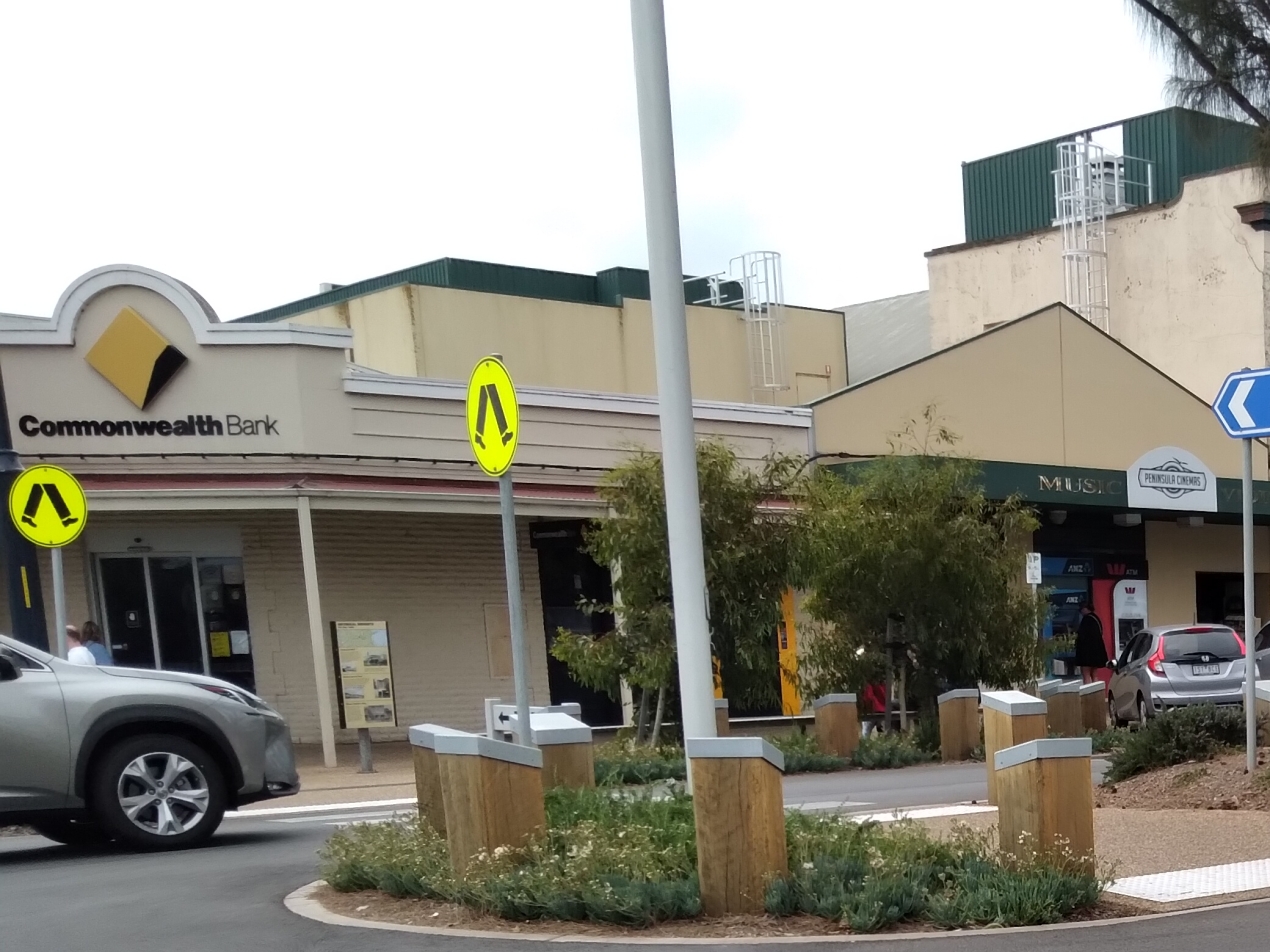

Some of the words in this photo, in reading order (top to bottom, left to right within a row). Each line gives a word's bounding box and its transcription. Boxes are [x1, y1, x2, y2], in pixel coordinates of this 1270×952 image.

[19, 415, 223, 437] Commonwealth
[226, 415, 280, 436] Bank
[1038, 475, 1123, 495] MUSIC
[1144, 472, 1176, 486] PENINSULA
[1176, 475, 1201, 487] CINEMAS
[1068, 565, 1083, 573] ANZ
